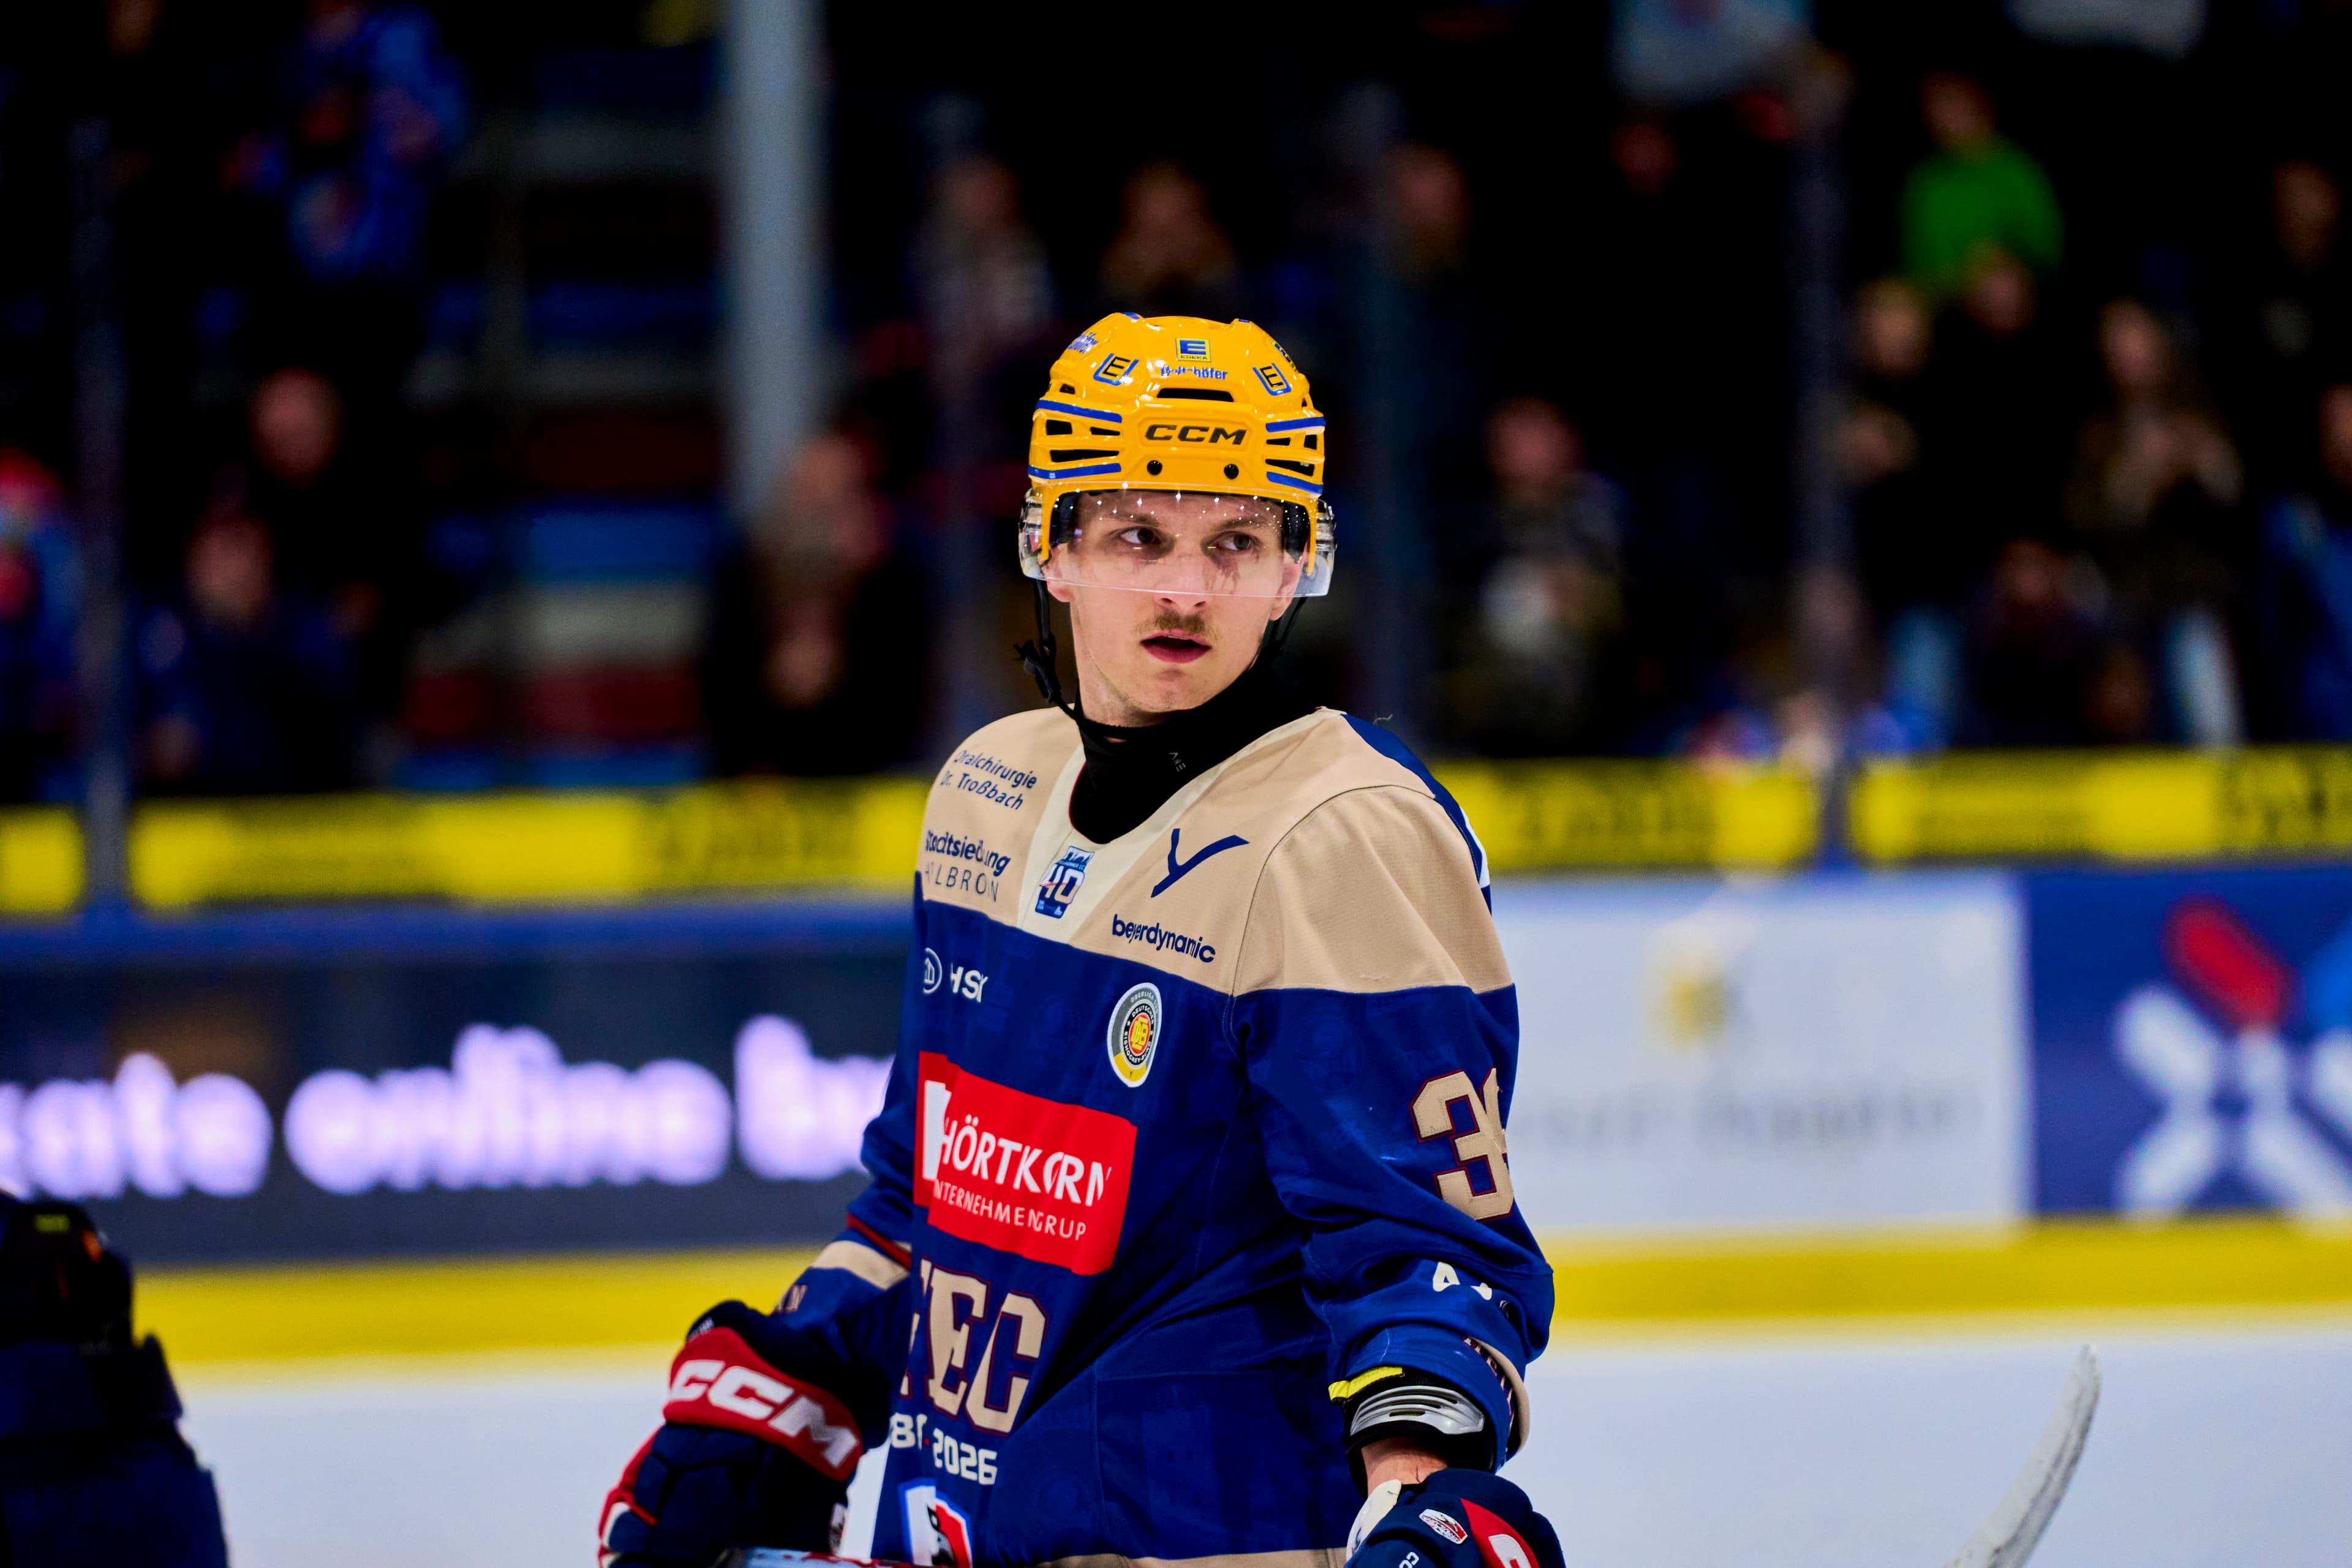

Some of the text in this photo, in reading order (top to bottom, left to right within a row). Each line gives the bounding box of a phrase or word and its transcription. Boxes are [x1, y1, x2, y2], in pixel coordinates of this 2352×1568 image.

[1144, 424, 1248, 445] CCM
[957, 772, 1023, 810] Troßbach
[668, 1360, 859, 1469] CCM
[932, 1428, 998, 1486] 2026
